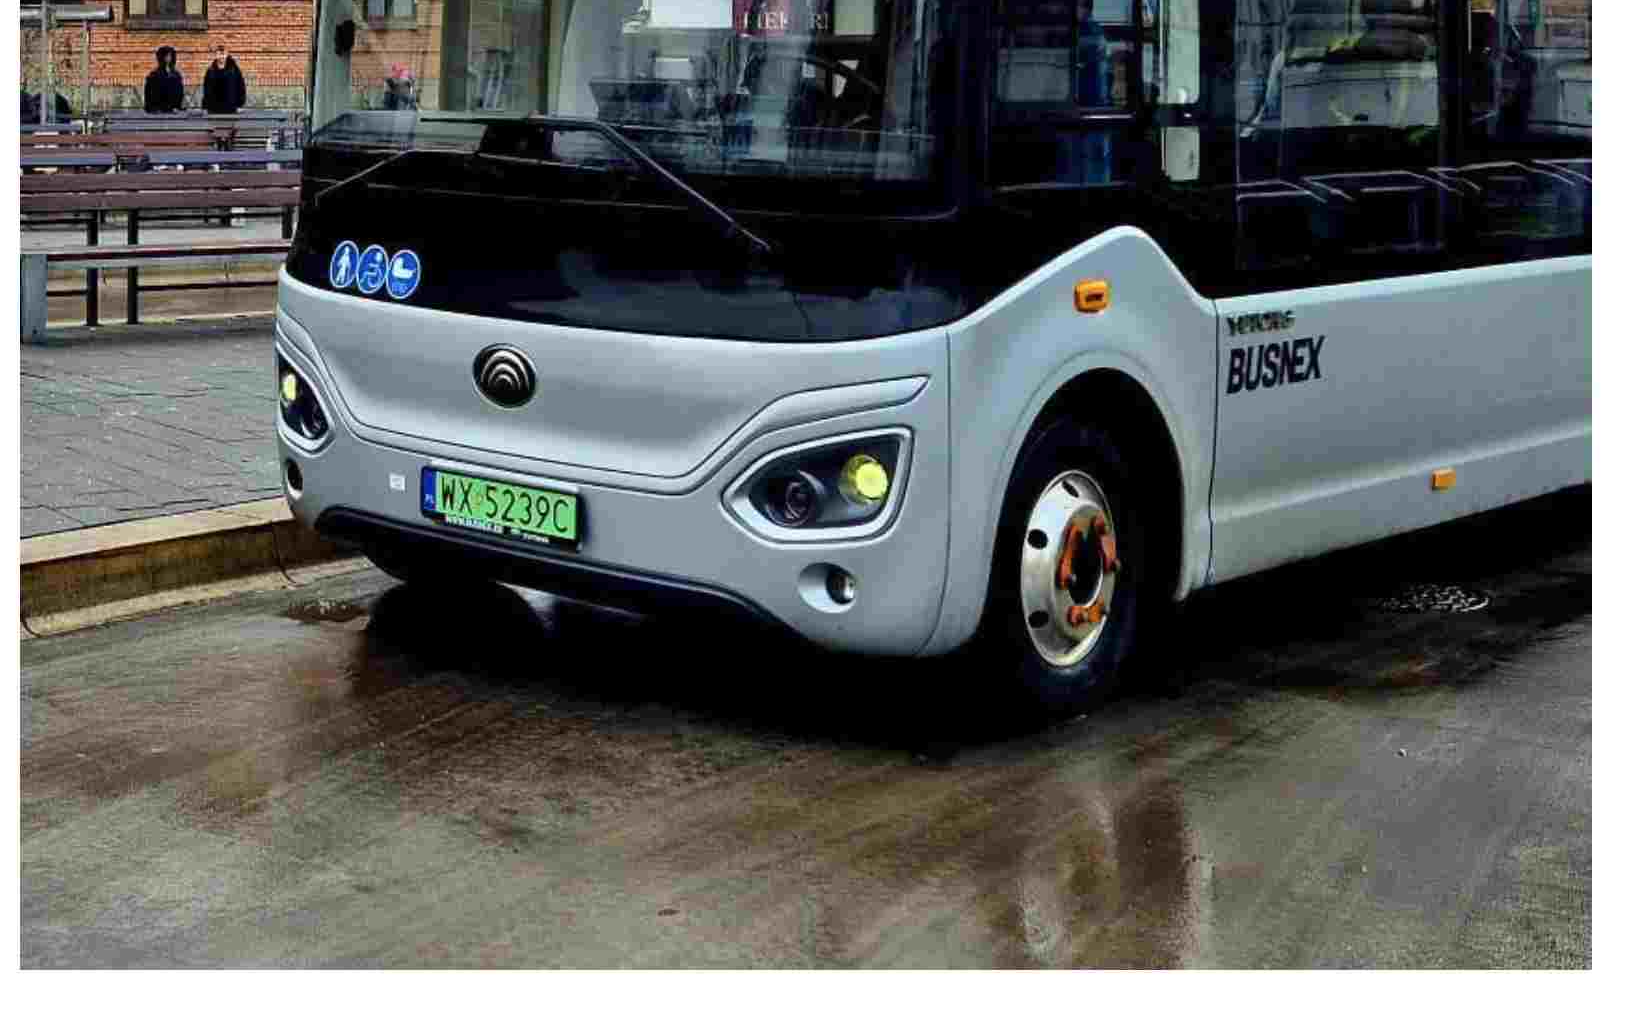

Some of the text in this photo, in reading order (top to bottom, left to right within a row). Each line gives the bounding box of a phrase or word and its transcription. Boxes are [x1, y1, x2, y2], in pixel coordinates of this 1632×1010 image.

[1226, 335, 1325, 394] BUSNEX
[441, 477, 473, 515] WX
[485, 485, 569, 533] 5239C
